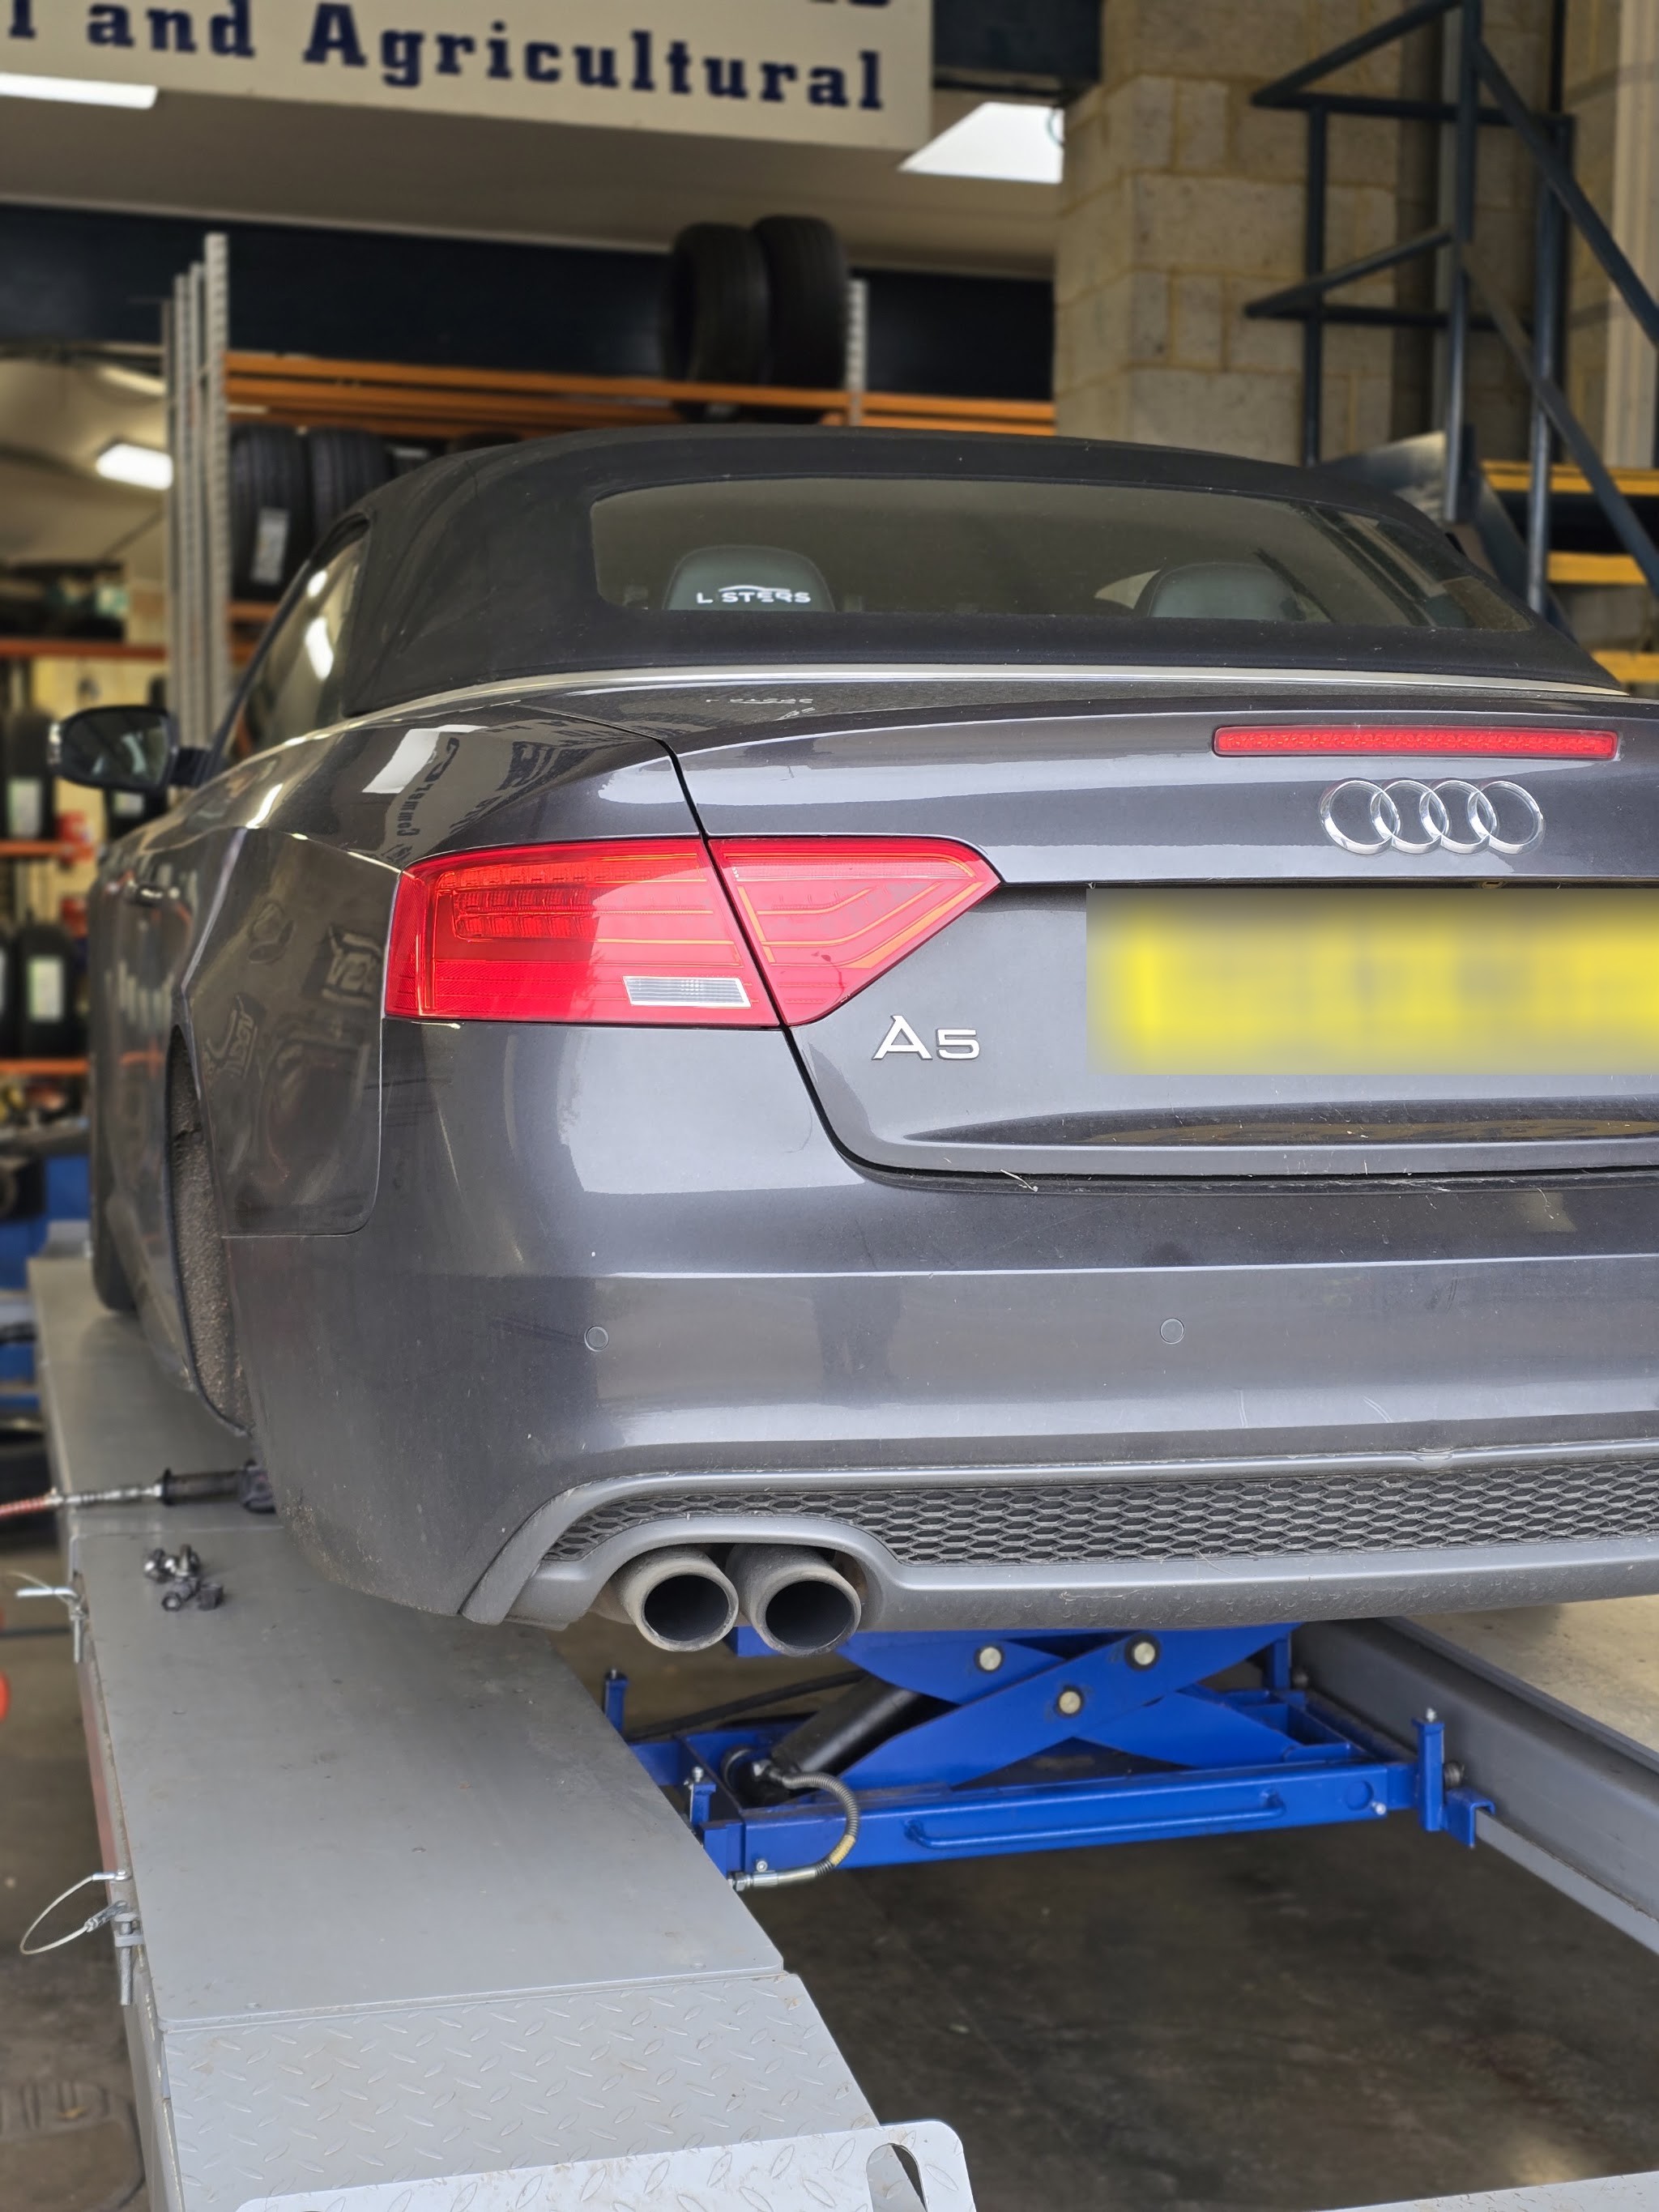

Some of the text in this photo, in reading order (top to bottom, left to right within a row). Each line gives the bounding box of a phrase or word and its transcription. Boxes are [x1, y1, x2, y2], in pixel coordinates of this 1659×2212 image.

[87, 0, 255, 58] and
[302, 2, 884, 110] Agricultural
[697, 591, 811, 604] LSTERS
[872, 1015, 980, 1060] A5
